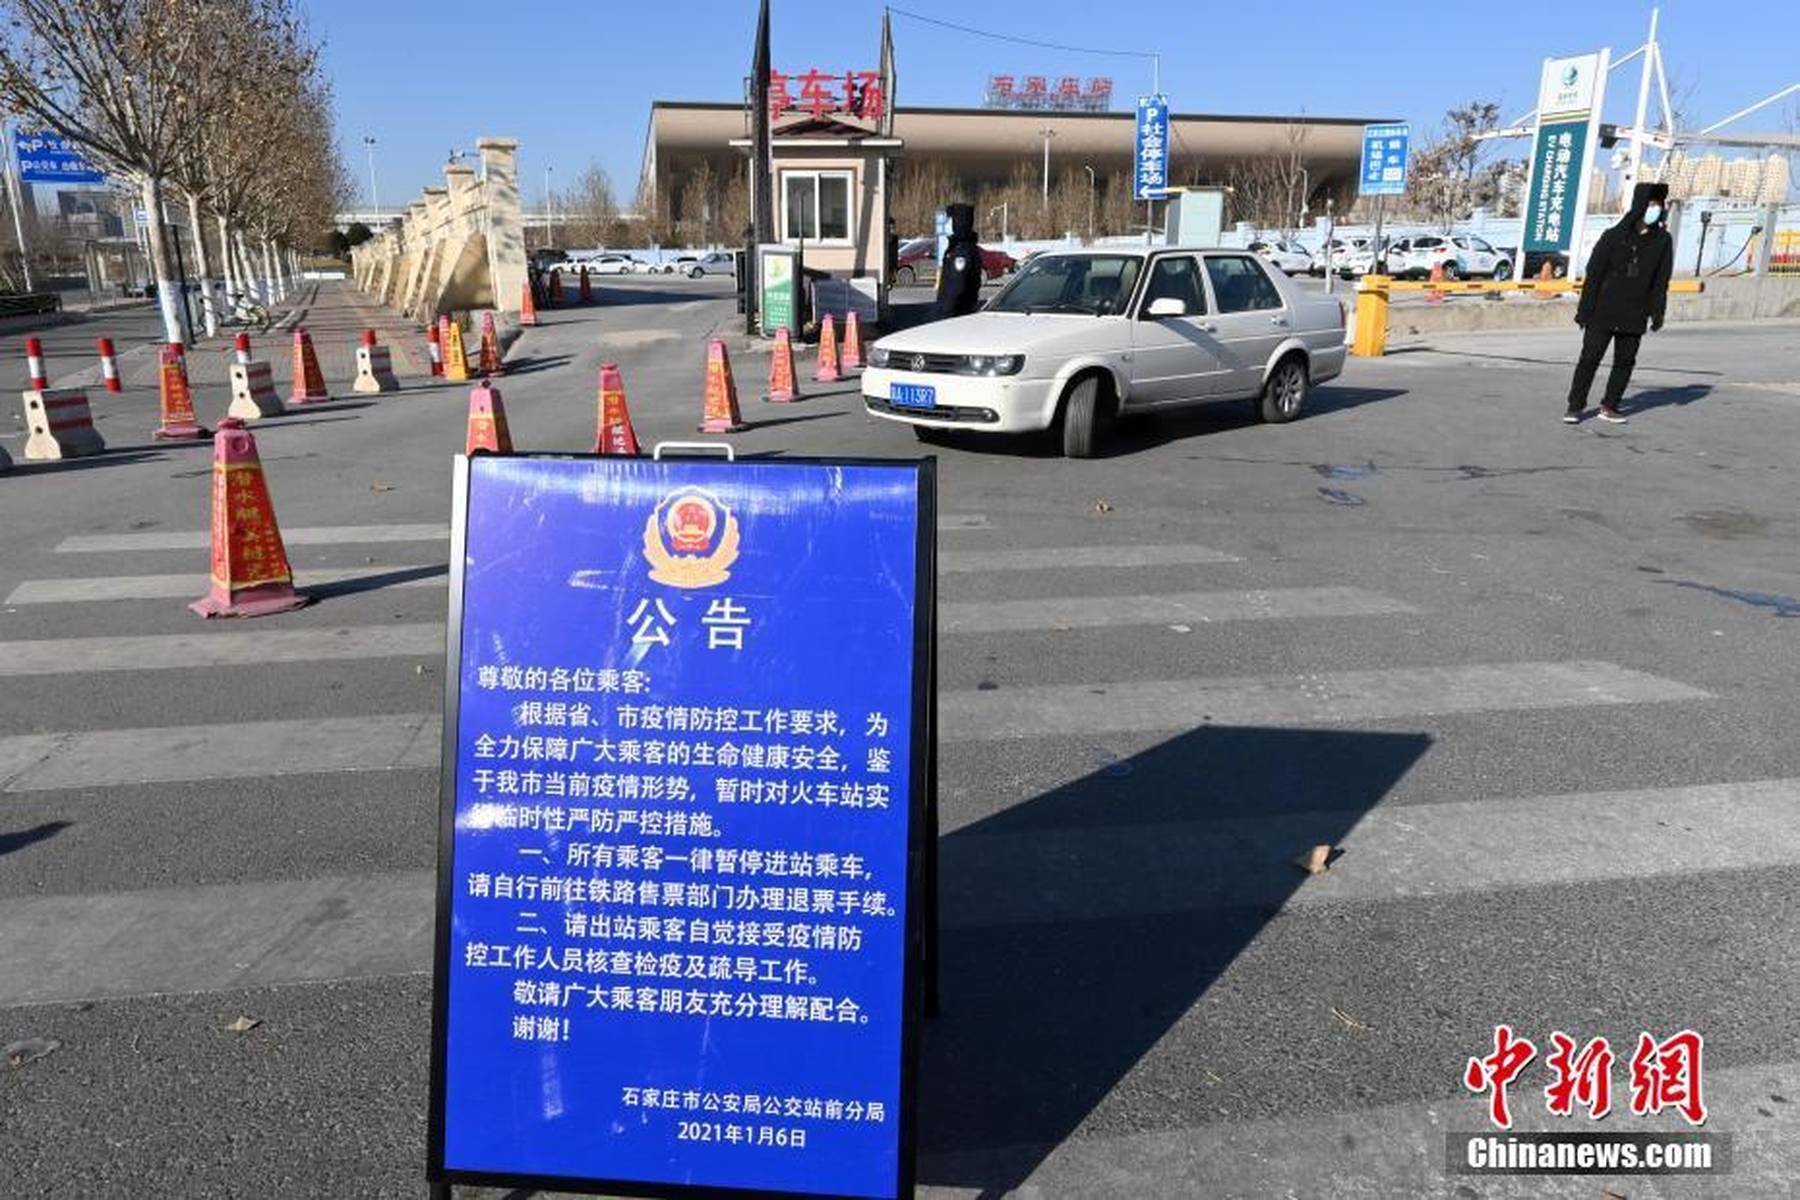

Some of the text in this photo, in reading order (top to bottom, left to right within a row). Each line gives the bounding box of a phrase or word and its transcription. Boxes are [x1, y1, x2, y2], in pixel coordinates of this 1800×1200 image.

[626, 596, 752, 650] 公告
[473, 734, 891, 774] 全力保障广大乘客的生命健康安全，鉴
[472, 770, 890, 810] 于我市当前疫情形势，暂时对火车站实
[470, 803, 724, 838] 临时性严防严控措施。
[467, 873, 898, 917] 请自行前往铁路售票部门办理退票手续。
[515, 911, 862, 952] 二、请出站乘客自觉接受疫情防
[465, 942, 819, 986] 控工作人员核查检疫及疏导工作。
[513, 980, 870, 1024] 敬请广大乘客朋友充分理解配合。
[622, 1087, 886, 1123] 石家庄市公安局公交站前分局
[677, 1121, 807, 1148] 2021年1月6日
